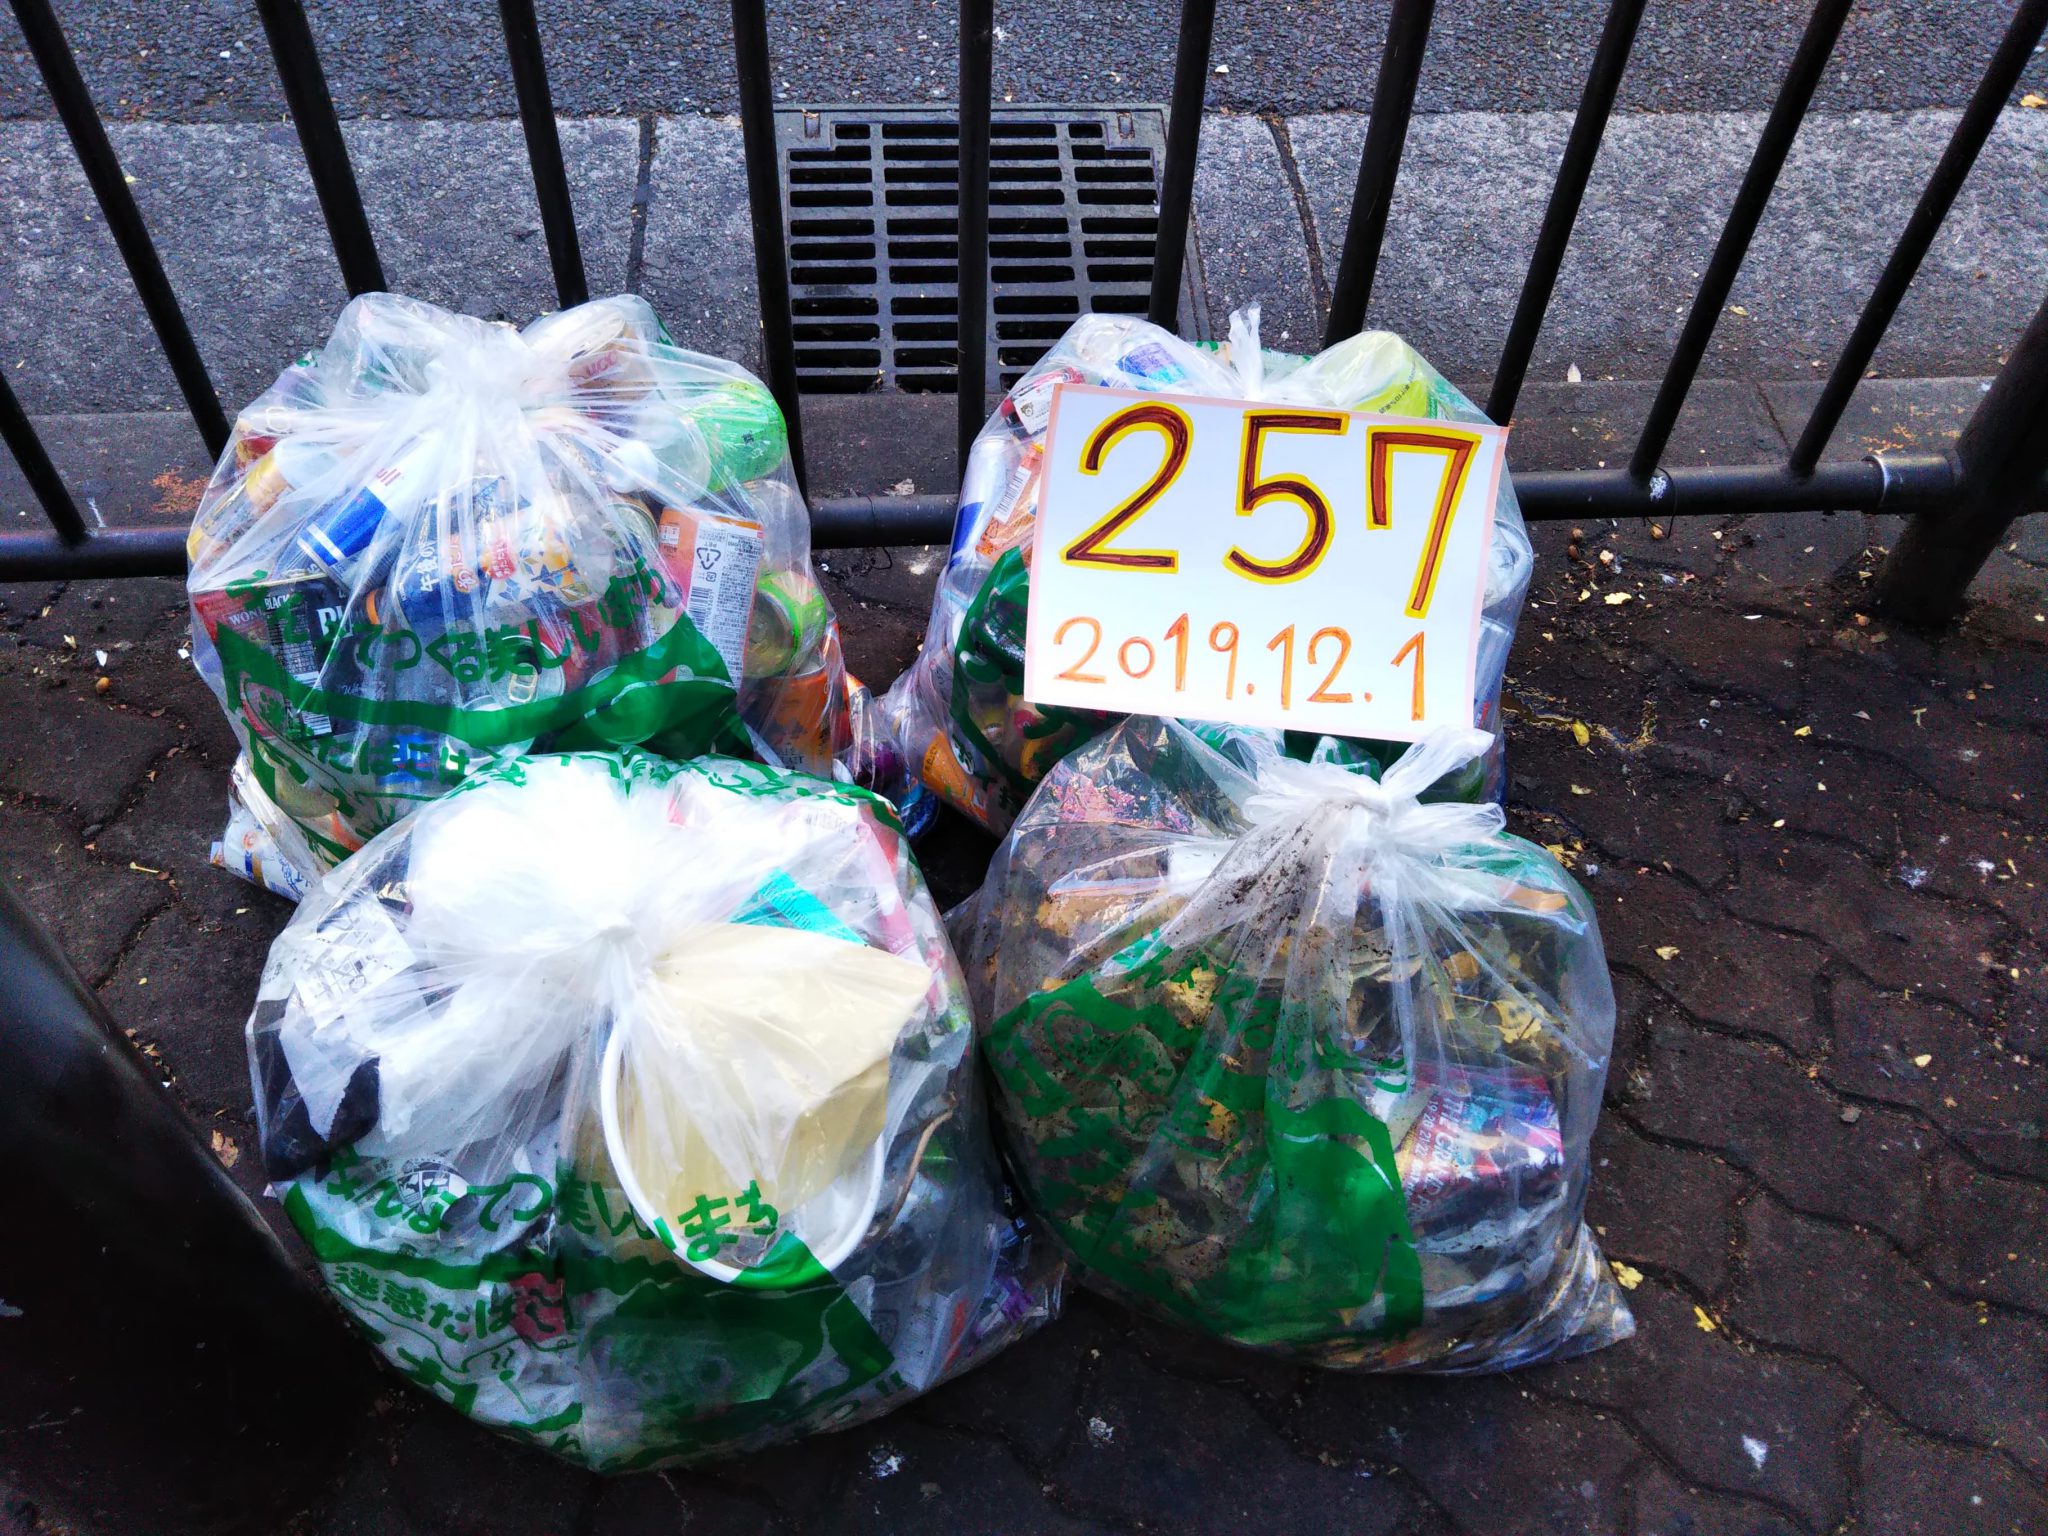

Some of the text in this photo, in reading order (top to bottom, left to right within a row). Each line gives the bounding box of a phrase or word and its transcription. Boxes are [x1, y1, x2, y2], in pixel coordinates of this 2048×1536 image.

[1060, 402, 1482, 619] 257
[1053, 612, 1426, 721] 2019.12.1
[334, 1264, 574, 1342] 迷惑たばこ
